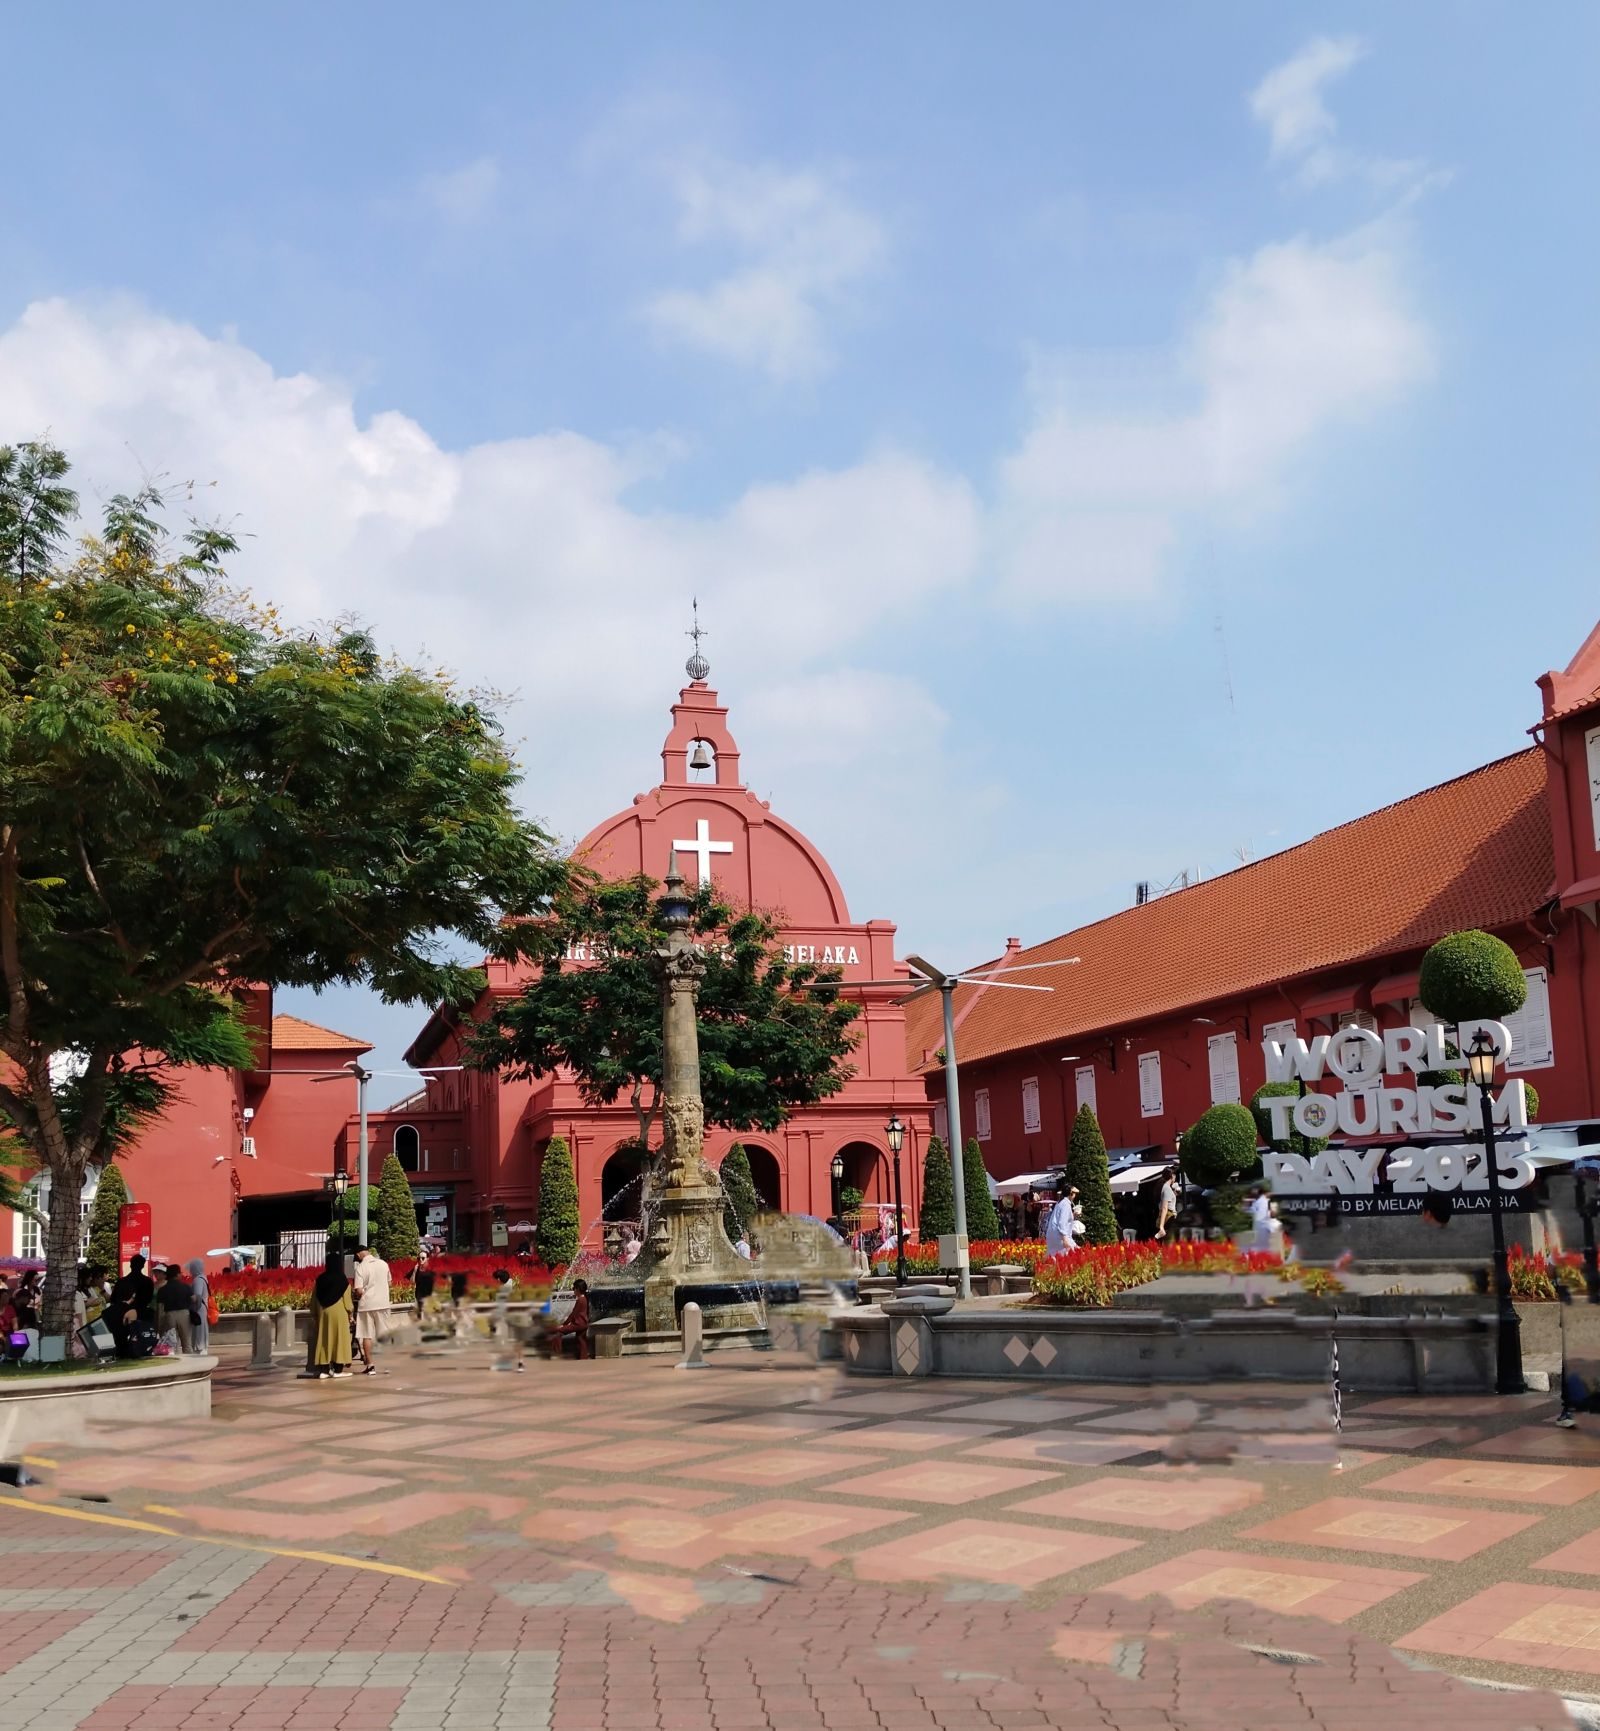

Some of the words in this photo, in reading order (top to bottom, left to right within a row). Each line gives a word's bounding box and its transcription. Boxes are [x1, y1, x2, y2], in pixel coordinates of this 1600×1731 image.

[783, 945, 860, 964] MELAKA
[1261, 1019, 1513, 1084] WORLD
[1259, 1078, 1527, 1141] TOURISM
[1262, 1148, 1387, 1196] DAY
[1386, 1142, 1536, 1195] 2025
[1355, 1199, 1374, 1212] BY
[1377, 1197, 1425, 1211] MELAK
